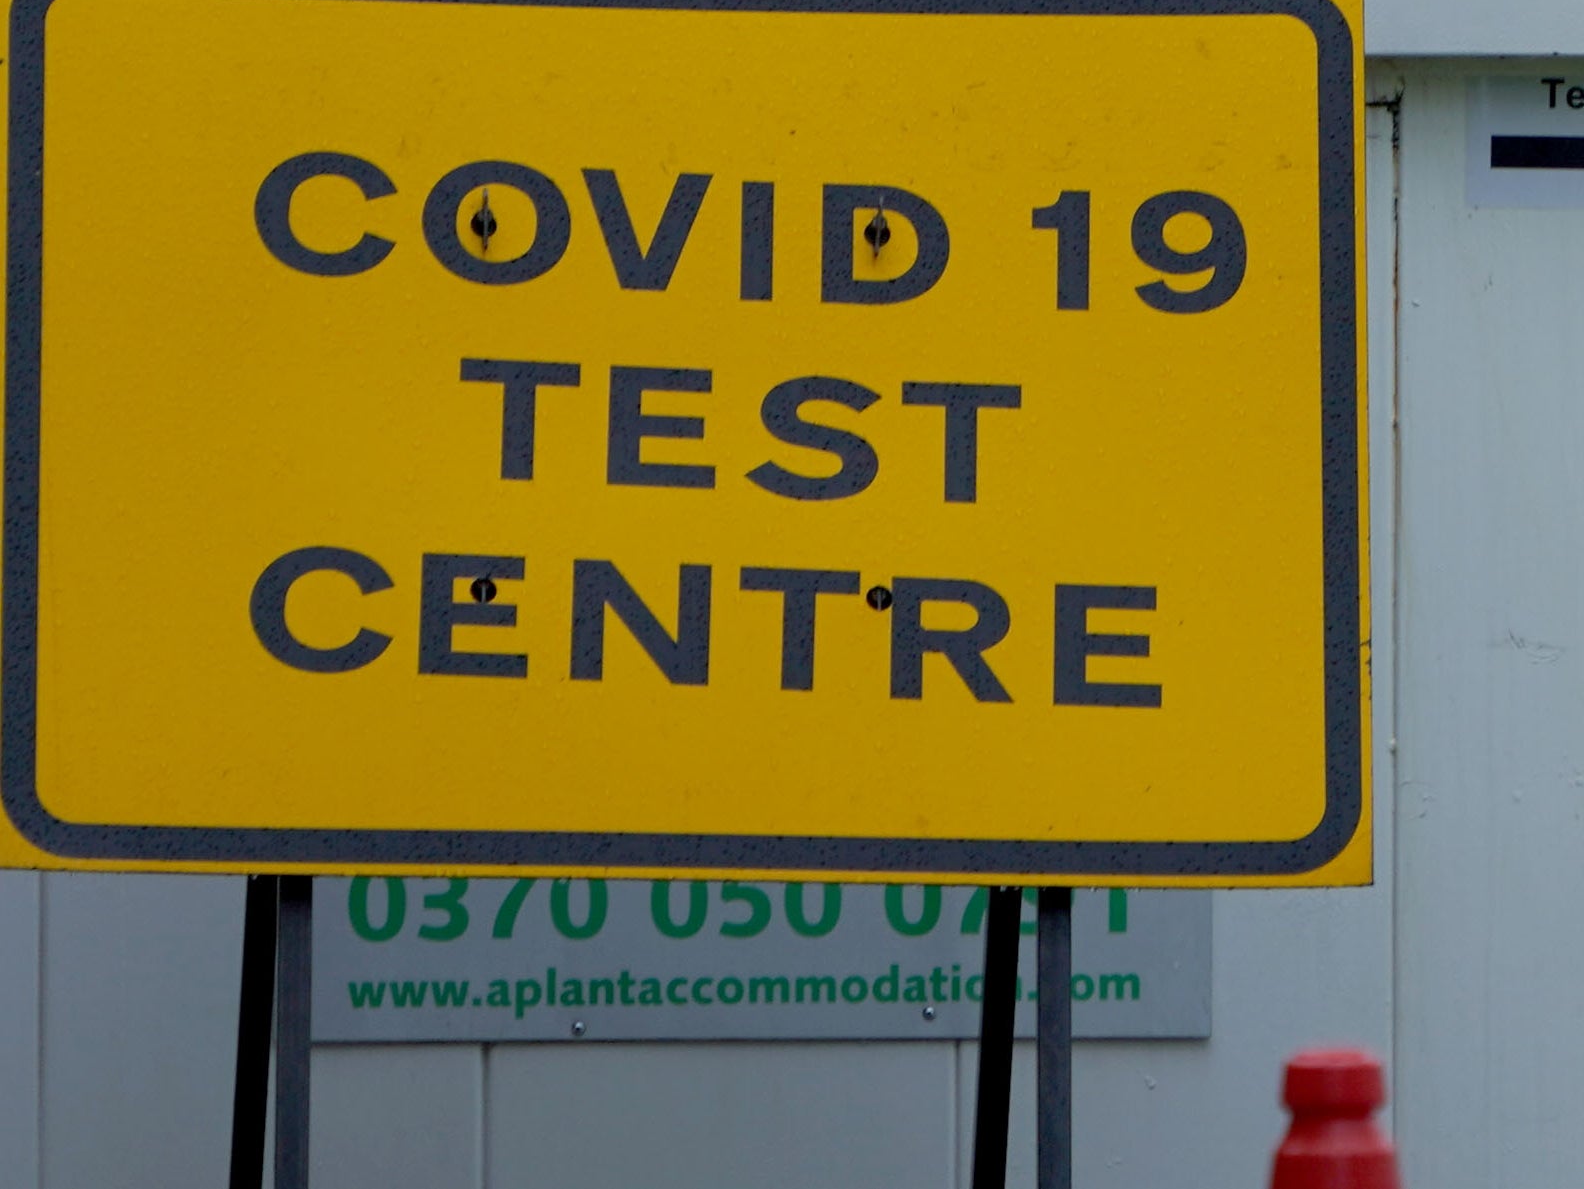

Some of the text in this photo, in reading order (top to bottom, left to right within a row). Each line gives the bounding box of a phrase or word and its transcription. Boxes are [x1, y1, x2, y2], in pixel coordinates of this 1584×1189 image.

[253, 150, 1248, 315] COVID 19
[459, 356, 1022, 504] TEST
[248, 544, 1163, 709] CENTRE
[348, 876, 608, 942] 0370
[650, 880, 843, 939] 050
[348, 963, 1141, 1018] www.aplantaccommodatio.om
